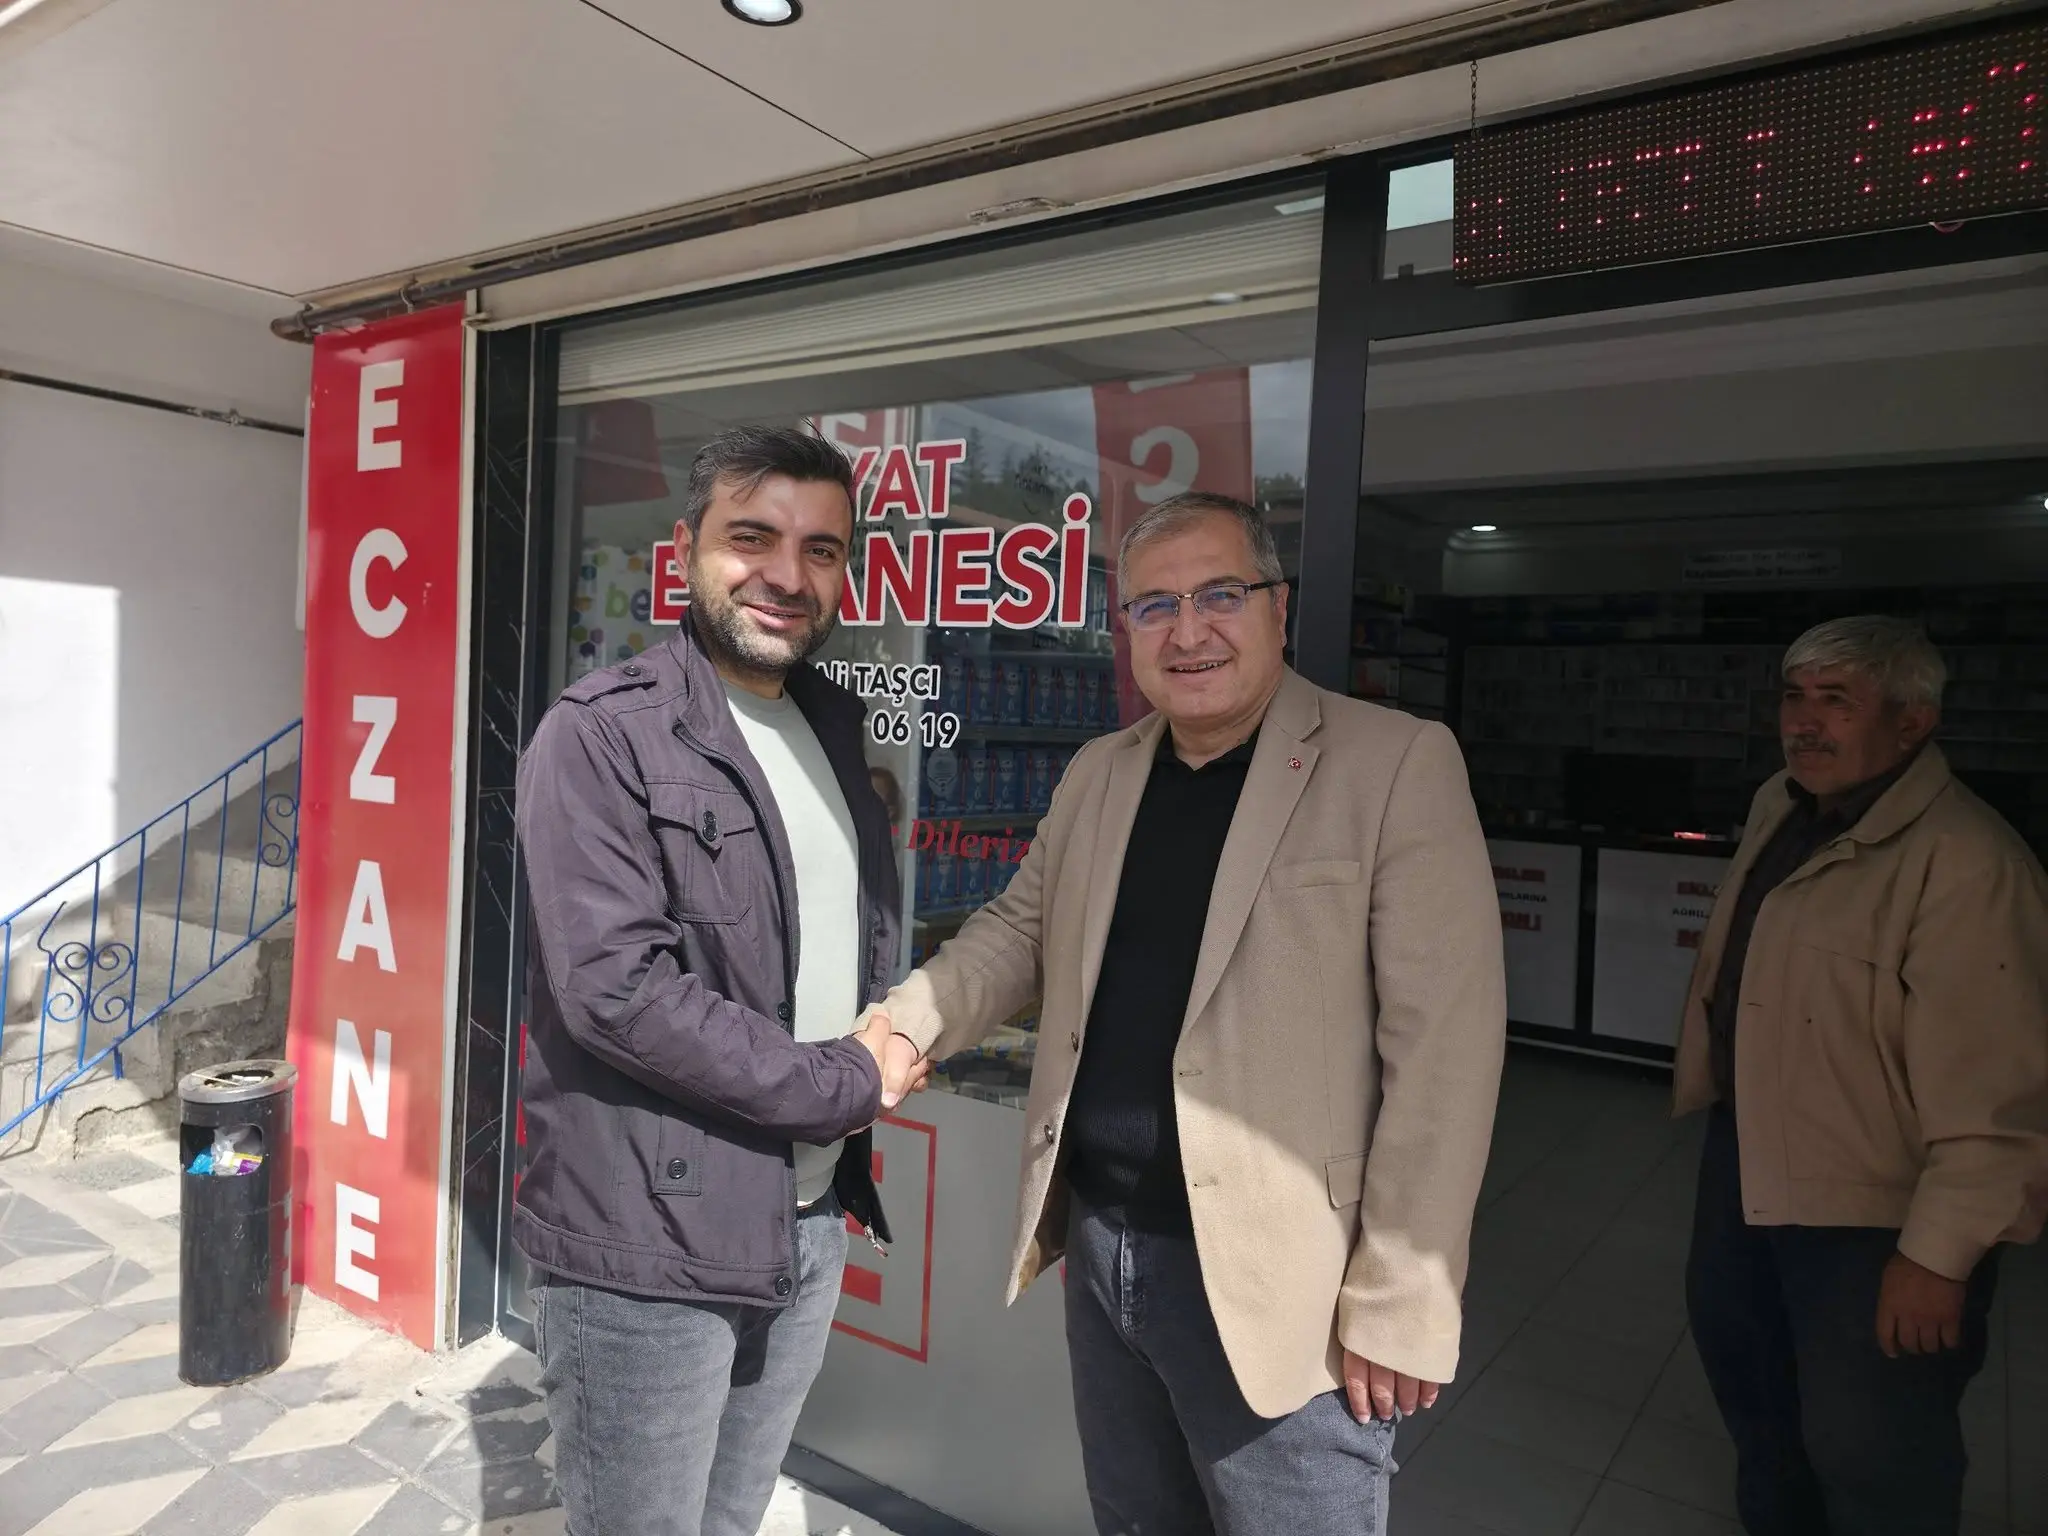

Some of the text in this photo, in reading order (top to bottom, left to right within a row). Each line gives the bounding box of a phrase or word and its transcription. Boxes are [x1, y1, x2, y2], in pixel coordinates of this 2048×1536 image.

[849, 438, 967, 522] YAT
[650, 492, 1091, 629] ENESİ
[852, 663, 941, 707] TAŞCI
[871, 709, 960, 748] 06 19
[330, 359, 408, 1303] ECZANE
[905, 818, 1030, 864] Dileriz
